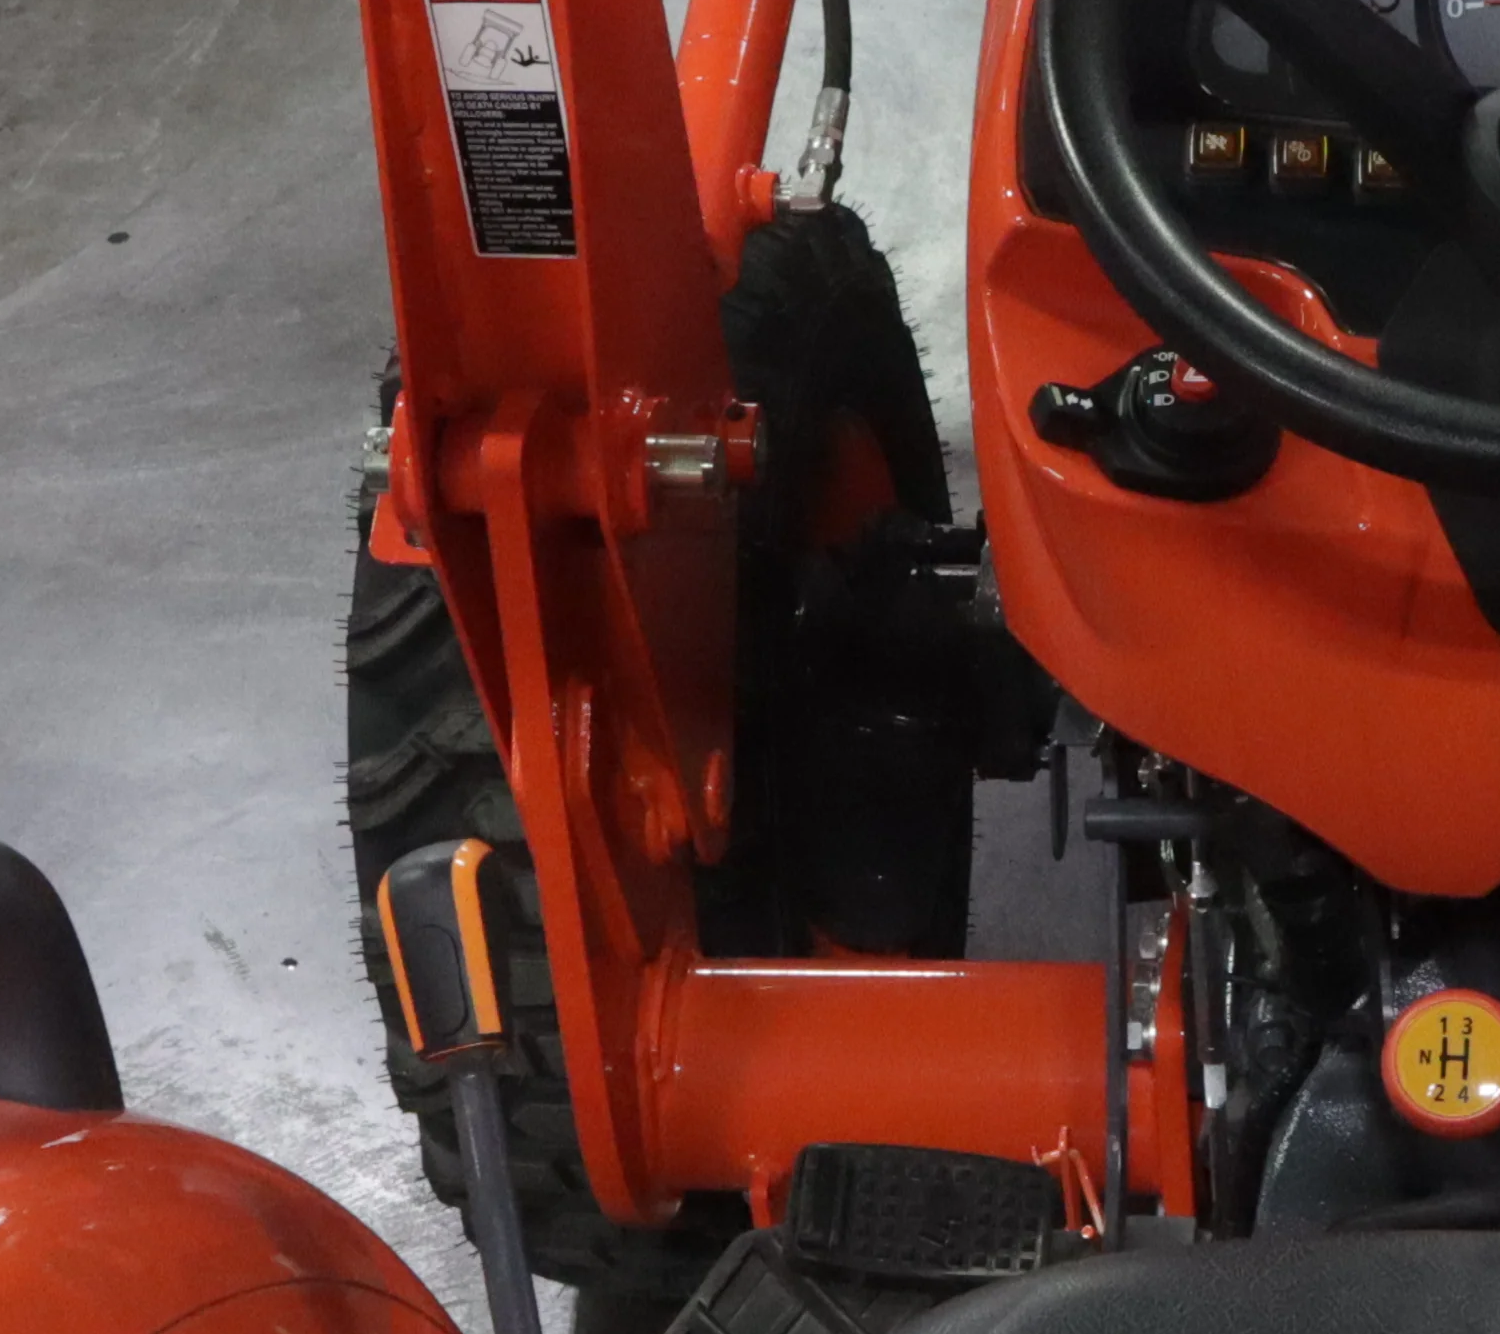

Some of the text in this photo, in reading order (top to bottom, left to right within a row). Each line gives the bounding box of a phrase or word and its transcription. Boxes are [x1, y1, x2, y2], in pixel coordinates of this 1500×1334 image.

[1440, 1016, 1473, 1036] 1 3
[1419, 1050, 1432, 1065] N
[1434, 1084, 1469, 1103] 2 4
